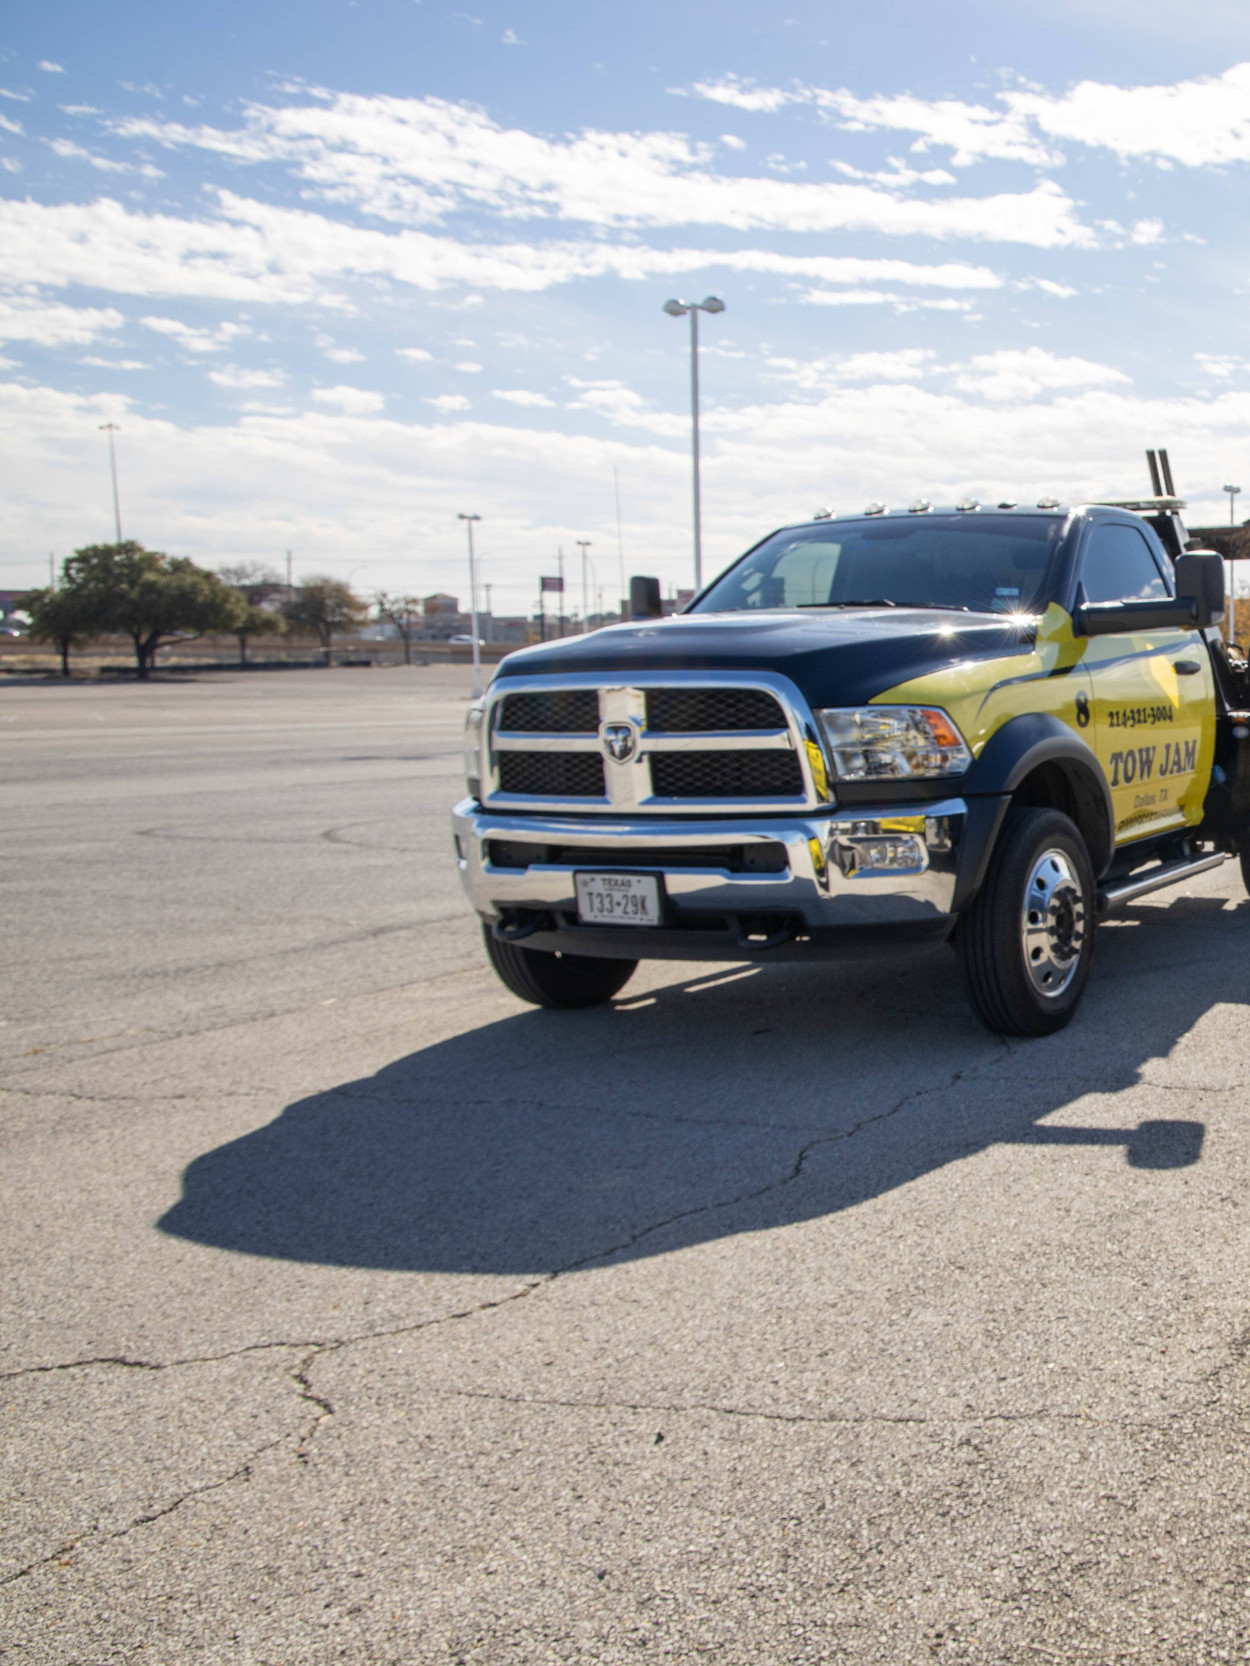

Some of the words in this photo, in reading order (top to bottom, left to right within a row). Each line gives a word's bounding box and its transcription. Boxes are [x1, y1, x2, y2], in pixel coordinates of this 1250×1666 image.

[1075, 690, 1090, 728] 8
[1108, 705, 1174, 728] 214-321-3004
[1109, 746, 1156, 787] TOW
[1159, 739, 1197, 777] JAM
[602, 878, 632, 888] TEXAS
